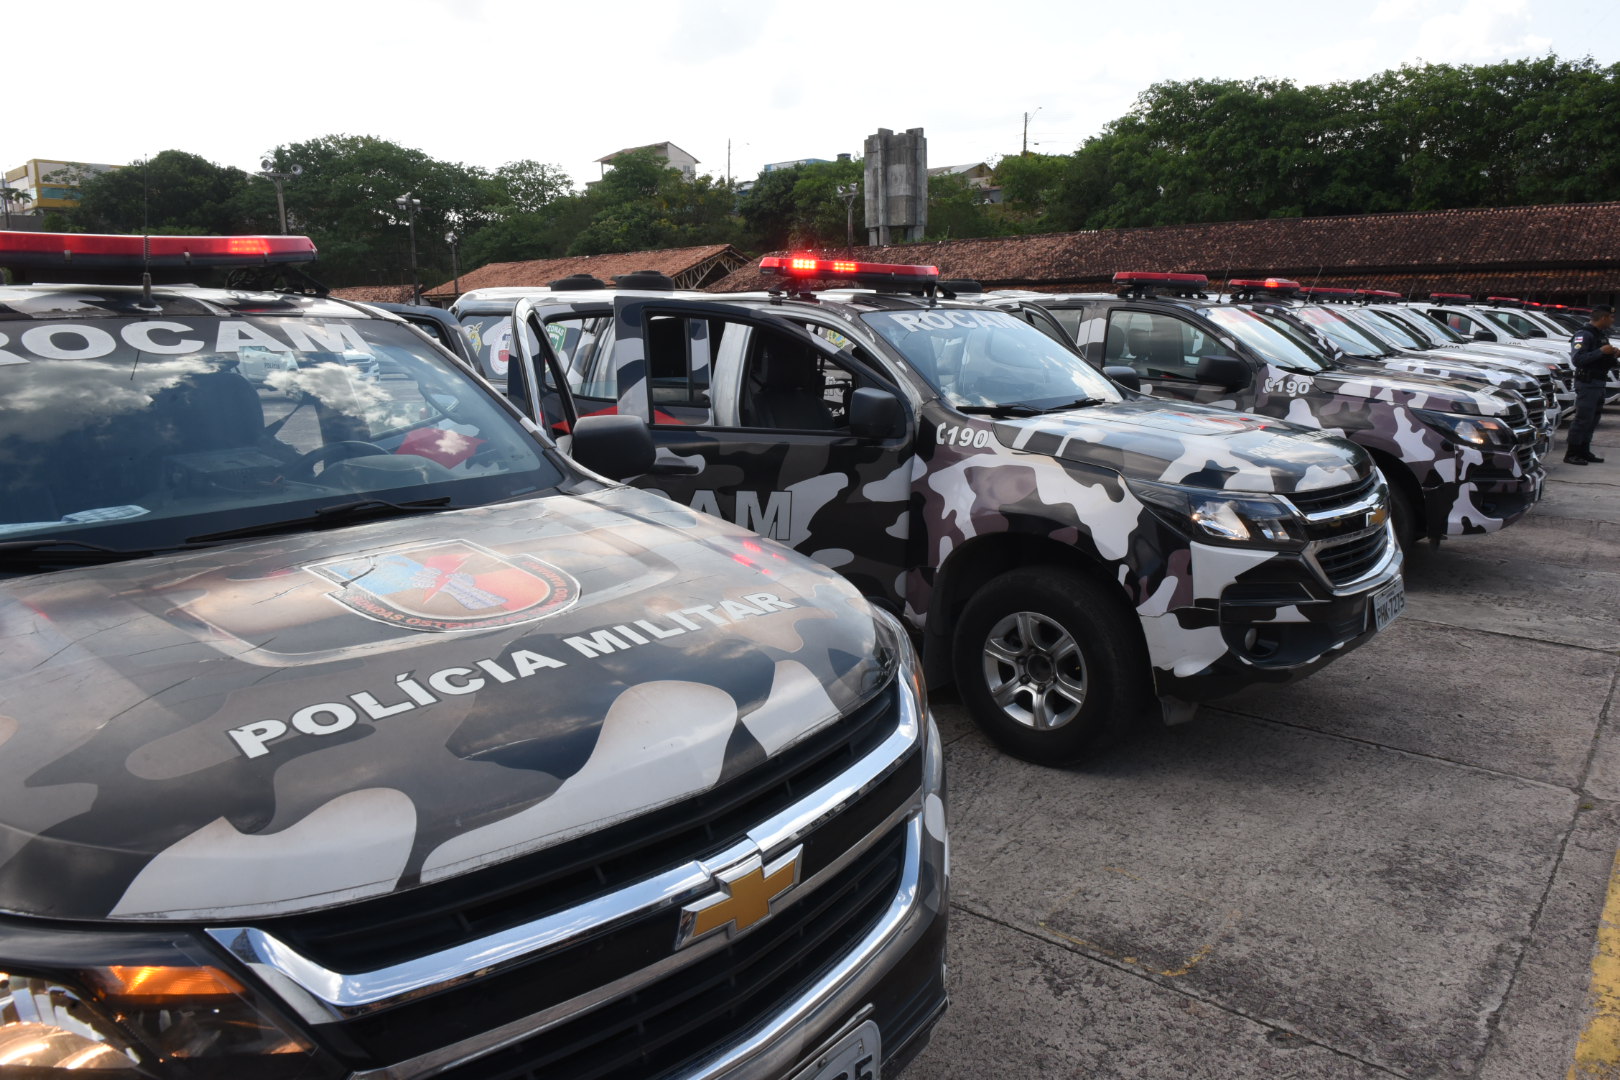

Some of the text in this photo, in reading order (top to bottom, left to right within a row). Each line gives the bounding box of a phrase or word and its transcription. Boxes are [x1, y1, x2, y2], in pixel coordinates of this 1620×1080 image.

[889, 311, 1025, 333] ROCAM
[1275, 381, 1310, 395] 190
[947, 426, 989, 449] 190
[227, 592, 798, 759] POLÍCIA MILITAR
